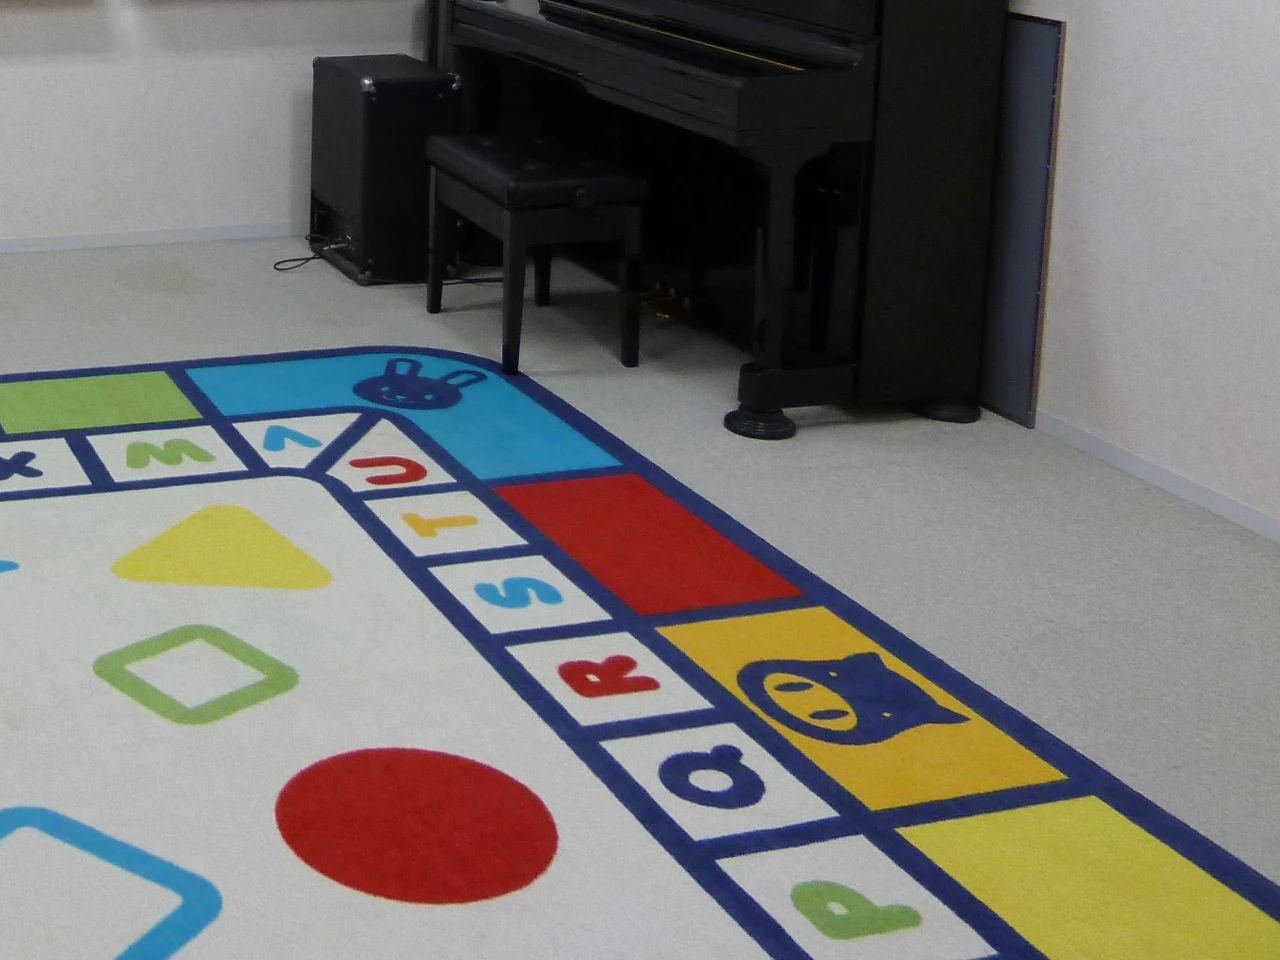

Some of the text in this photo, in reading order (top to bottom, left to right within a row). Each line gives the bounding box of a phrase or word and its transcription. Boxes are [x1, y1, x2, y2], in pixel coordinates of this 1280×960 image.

[126, 439, 216, 468] W
[264, 426, 322, 452] V
[351, 457, 427, 485] U
[402, 514, 478, 537] T
[475, 577, 564, 608] S
[559, 655, 660, 698] R
[660, 745, 765, 808] Q
[794, 884, 919, 939] P
